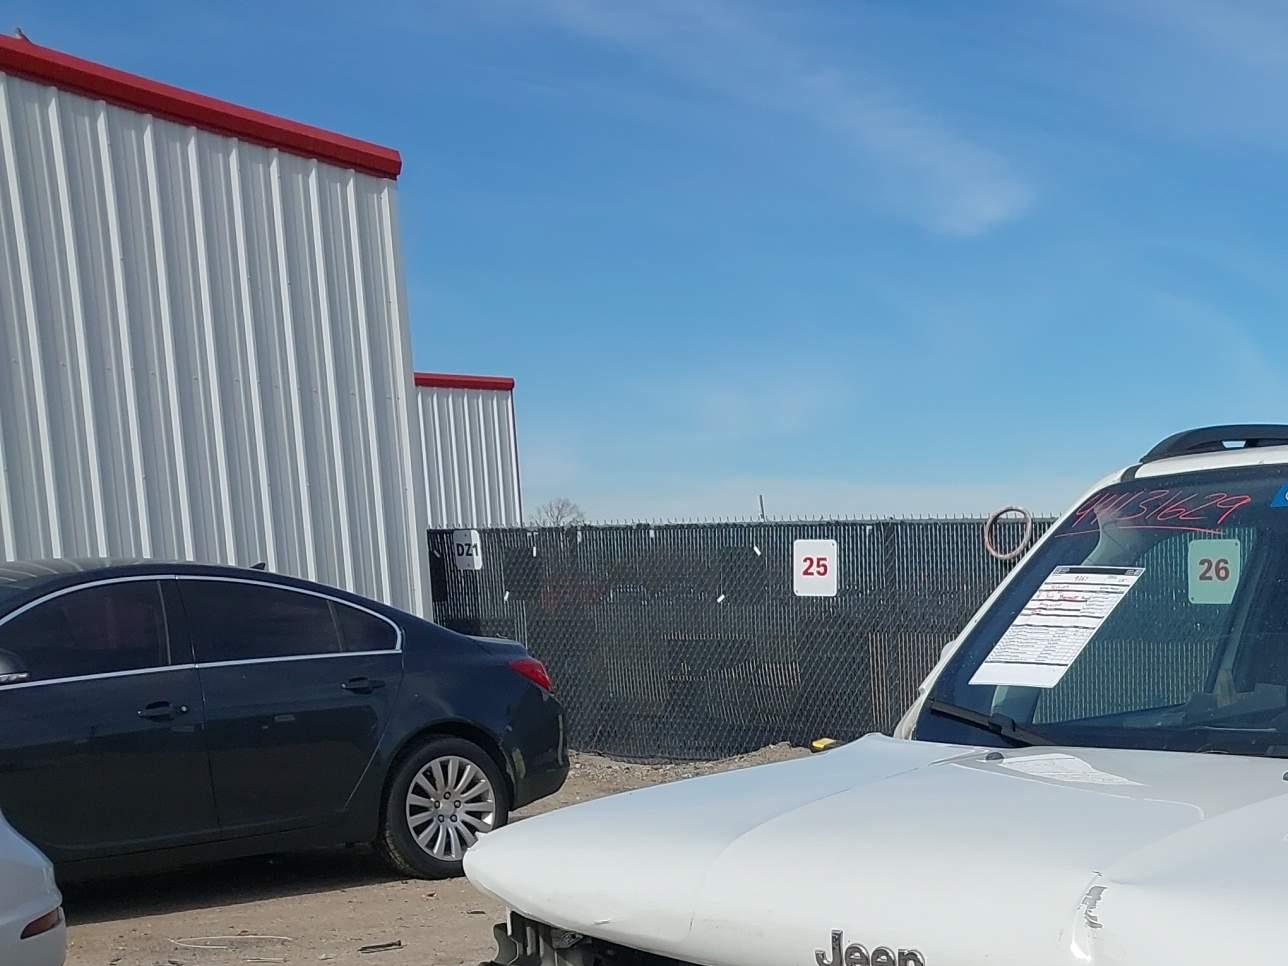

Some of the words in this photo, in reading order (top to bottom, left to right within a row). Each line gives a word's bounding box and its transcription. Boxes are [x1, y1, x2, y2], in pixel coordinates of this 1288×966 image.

[456, 543, 479, 557] DZ1
[802, 557, 828, 576] 25
[1199, 558, 1230, 581] 26
